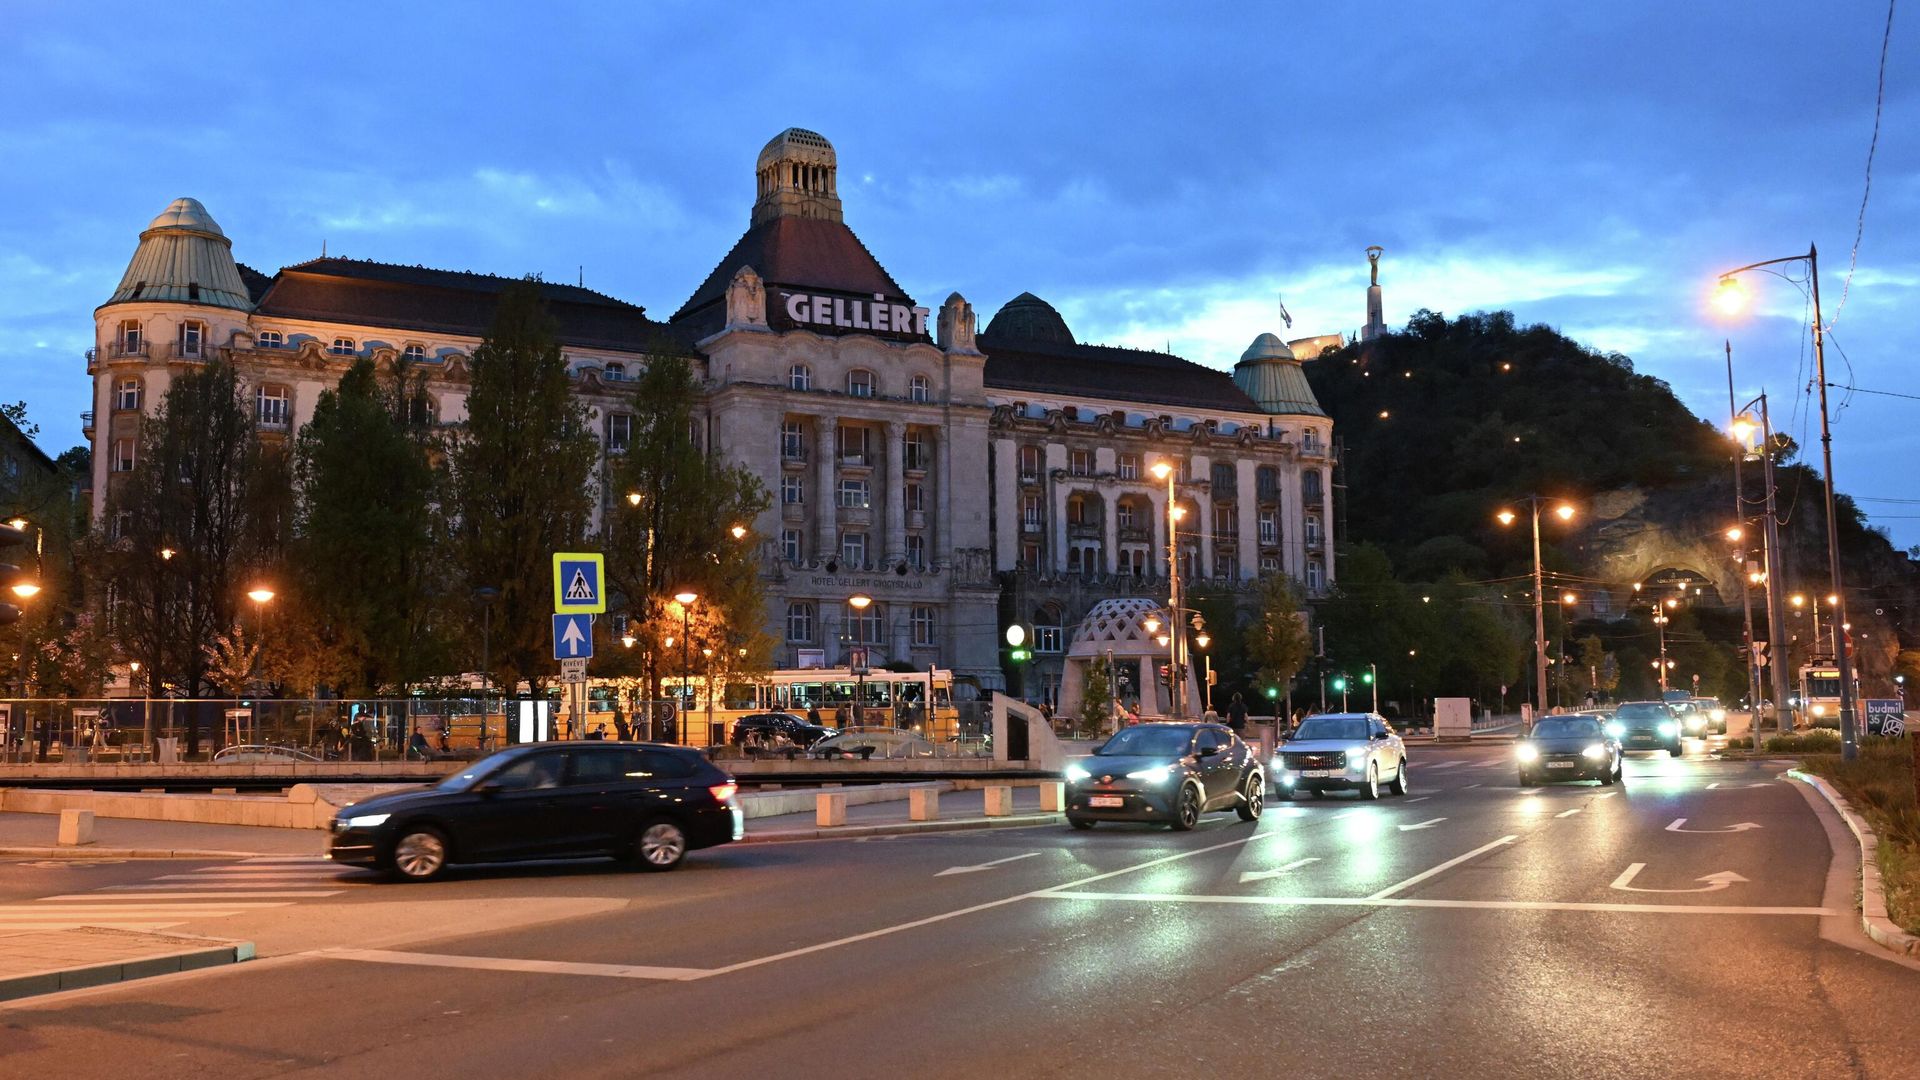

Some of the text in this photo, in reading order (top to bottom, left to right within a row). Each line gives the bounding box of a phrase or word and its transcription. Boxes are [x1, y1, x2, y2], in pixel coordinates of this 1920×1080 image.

[811, 576, 836, 586] HOTEL
[1868, 702, 1902, 713] budmil
[1869, 714, 1880, 724] 35
